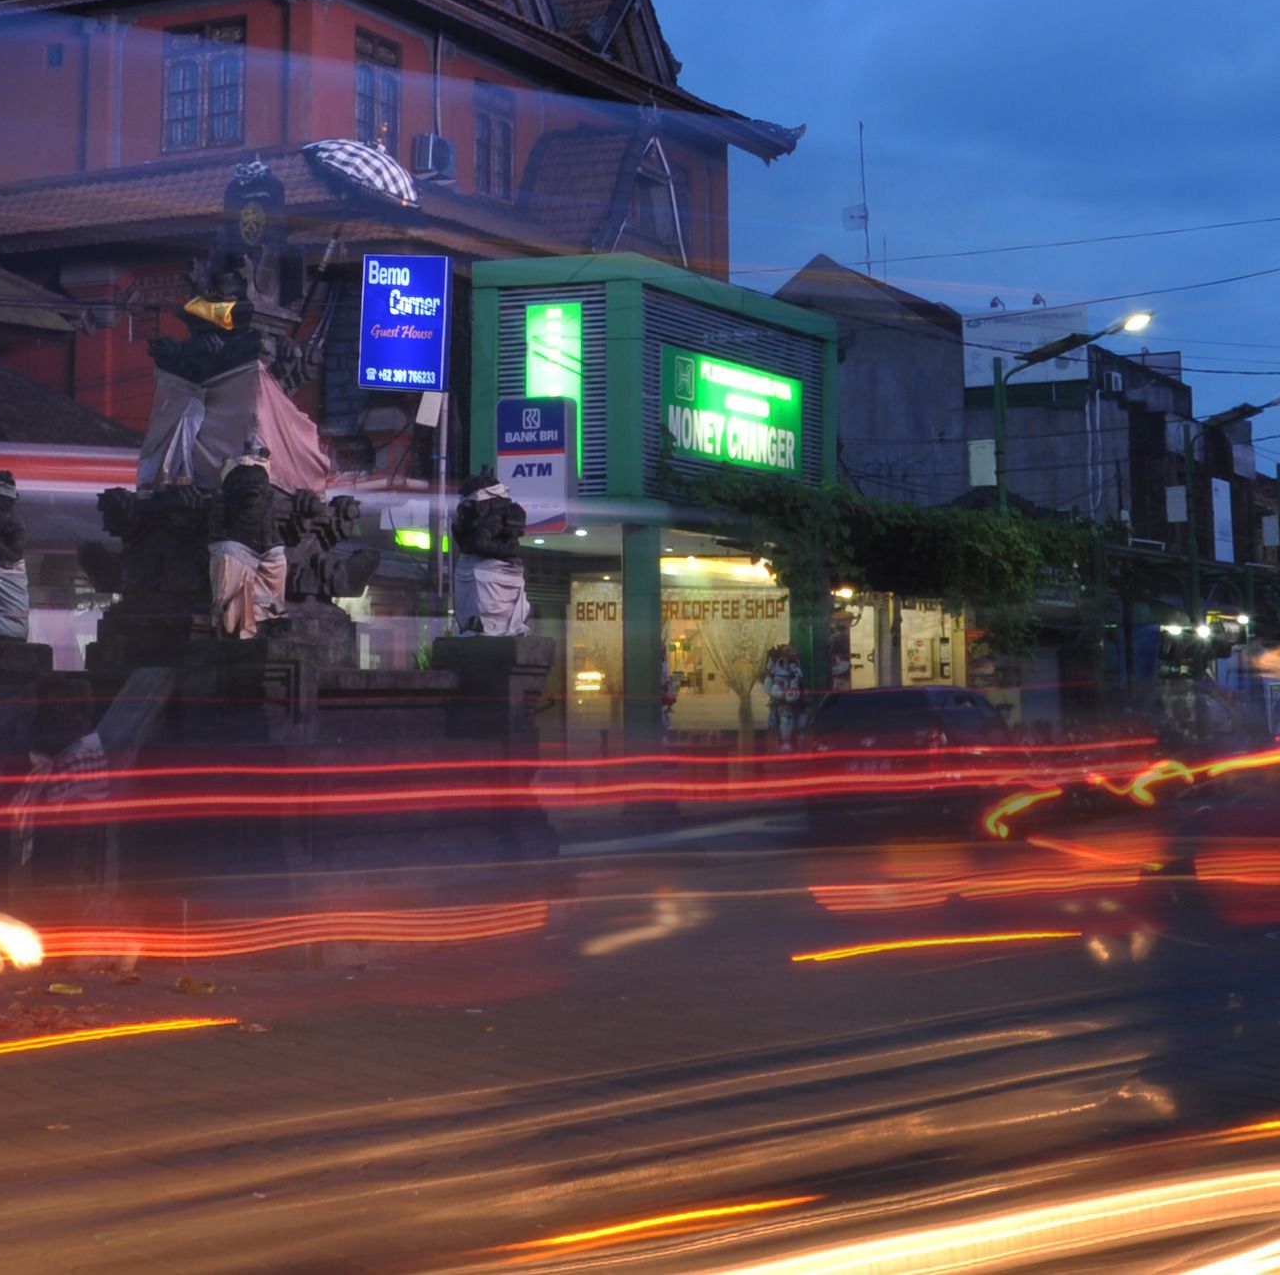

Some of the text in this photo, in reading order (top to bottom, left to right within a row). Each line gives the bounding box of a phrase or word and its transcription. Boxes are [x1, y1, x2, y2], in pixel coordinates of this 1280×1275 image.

[368, 260, 410, 286] Bemo
[389, 289, 440, 317] Corner
[371, 323, 433, 340] Guest House
[505, 430, 559, 444] BANK BRI
[669, 405, 725, 455] MONEY
[727, 416, 796, 470] CHANGER
[512, 462, 553, 479] ATM
[576, 601, 617, 622] BEMO
[745, 598, 786, 620] SHOP
